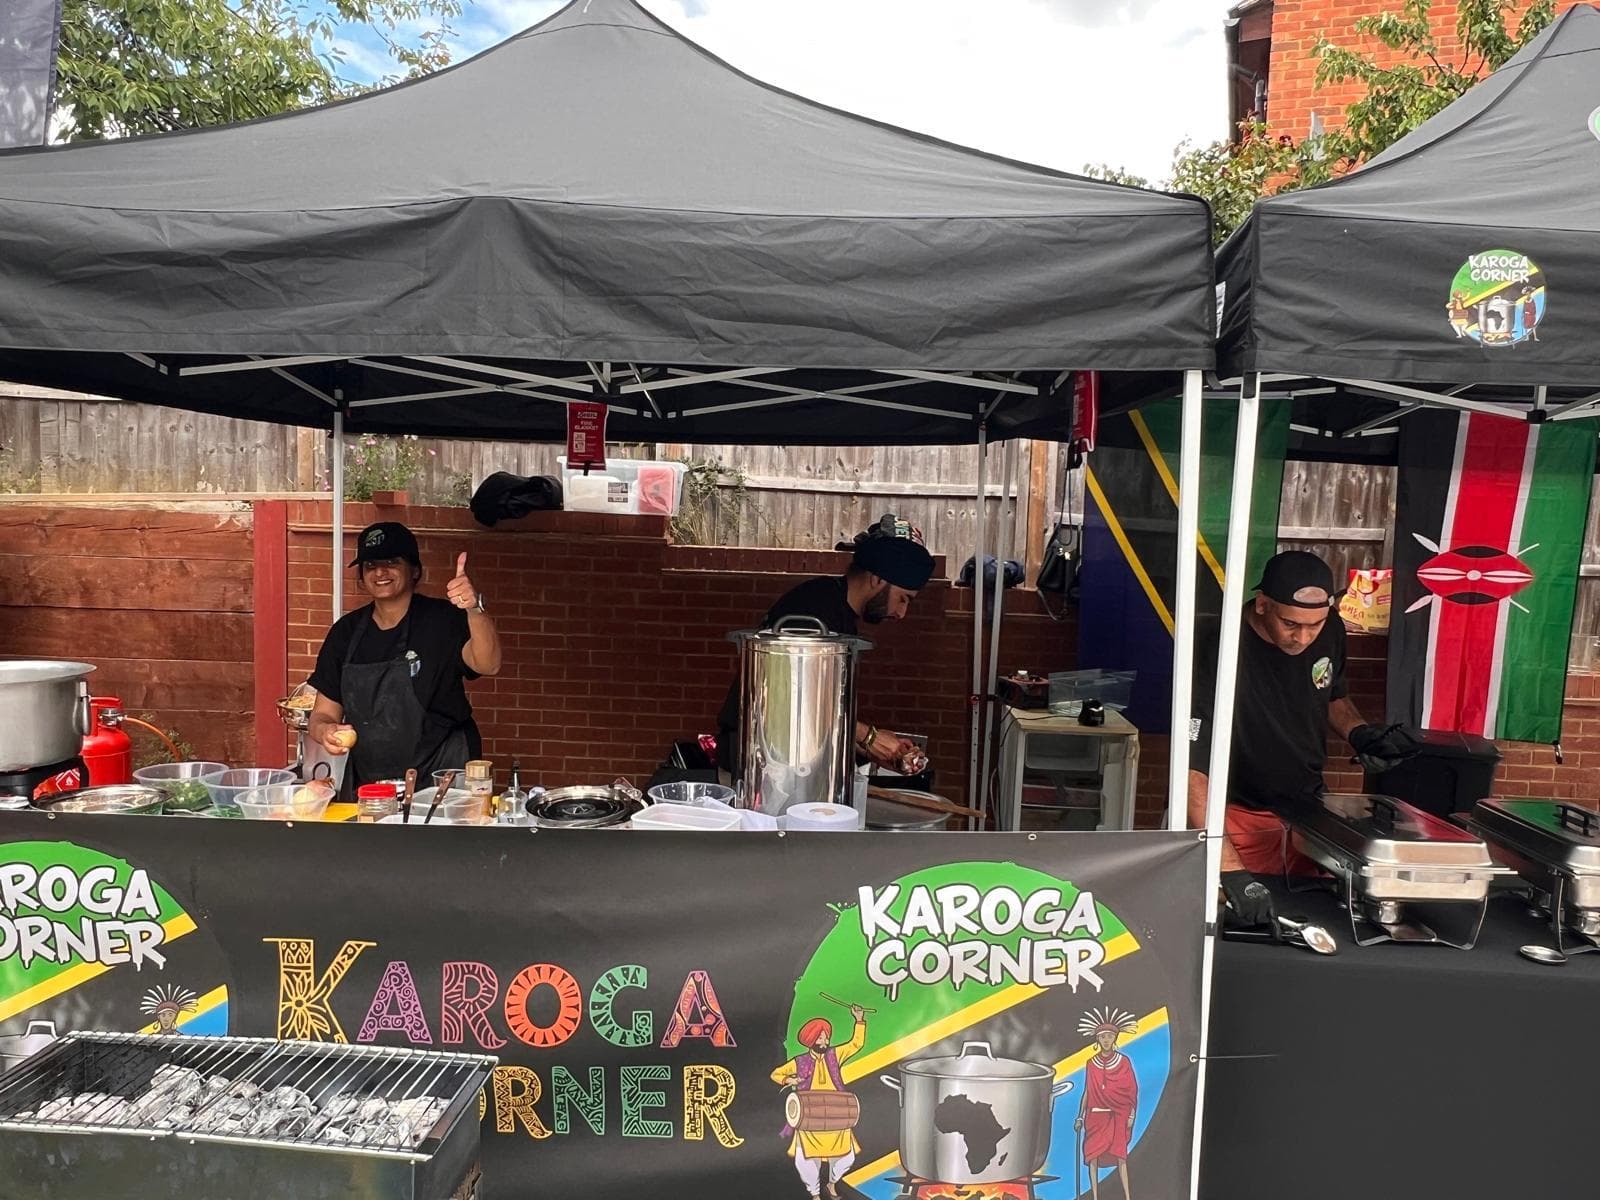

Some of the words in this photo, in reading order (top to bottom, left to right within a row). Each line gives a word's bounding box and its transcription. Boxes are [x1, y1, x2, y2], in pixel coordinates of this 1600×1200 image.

[1469, 255, 1529, 270] KAROGA
[1470, 269, 1530, 283] CORNER
[0, 863, 161, 918] ROGA
[858, 884, 1103, 948] KAROGA
[262, 937, 738, 1050] KAROGA
[867, 938, 1106, 1001] CORNER
[480, 1065, 745, 1148] RNER
